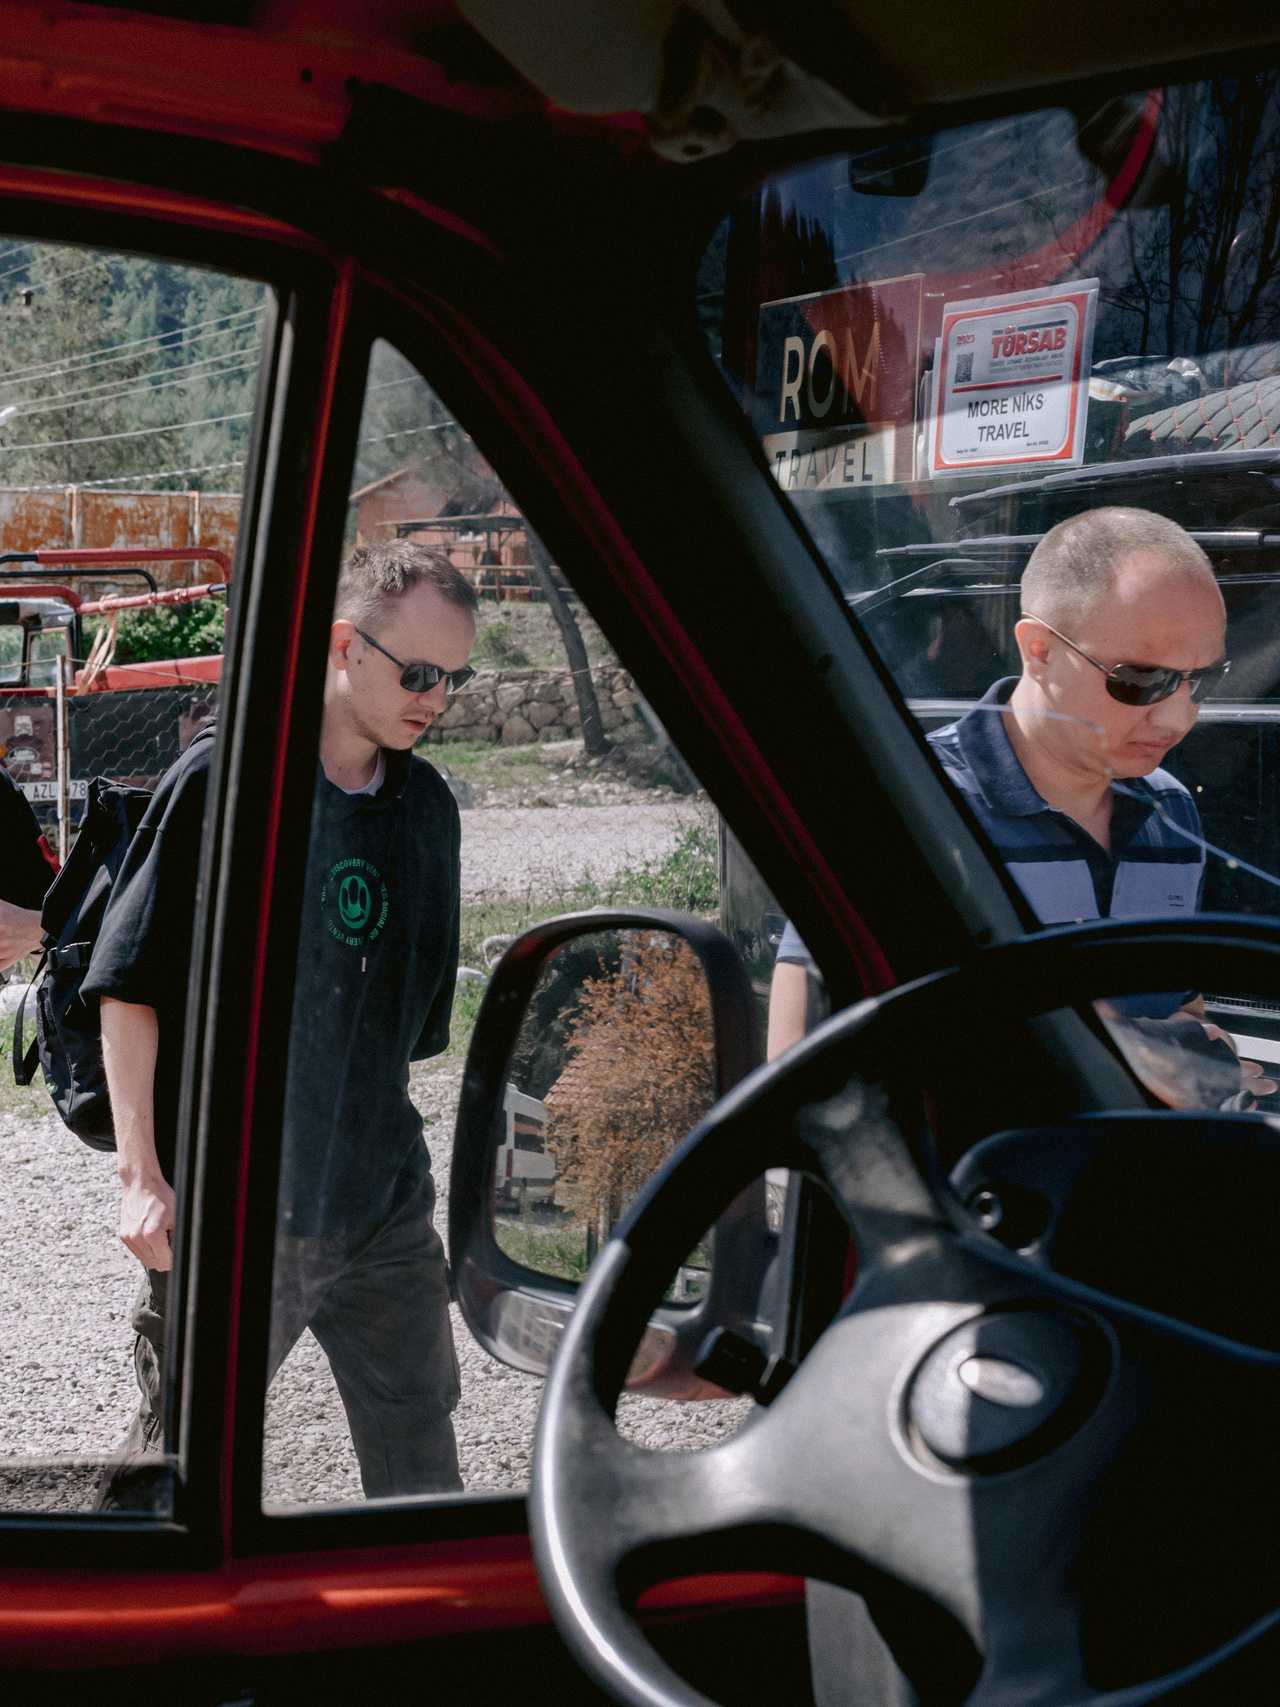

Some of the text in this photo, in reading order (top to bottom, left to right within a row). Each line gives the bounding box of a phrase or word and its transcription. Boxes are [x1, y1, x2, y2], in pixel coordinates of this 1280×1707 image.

[991, 325, 1067, 359] TÜRSAB
[967, 391, 1044, 419] MORE NİKS
[978, 422, 1030, 443] TRAVEL
[775, 442, 873, 488] TRAVEL
[33, 784, 56, 799] AZL
[331, 858, 366, 876] DISCOVERY
[376, 901, 389, 929] SOCIAL
